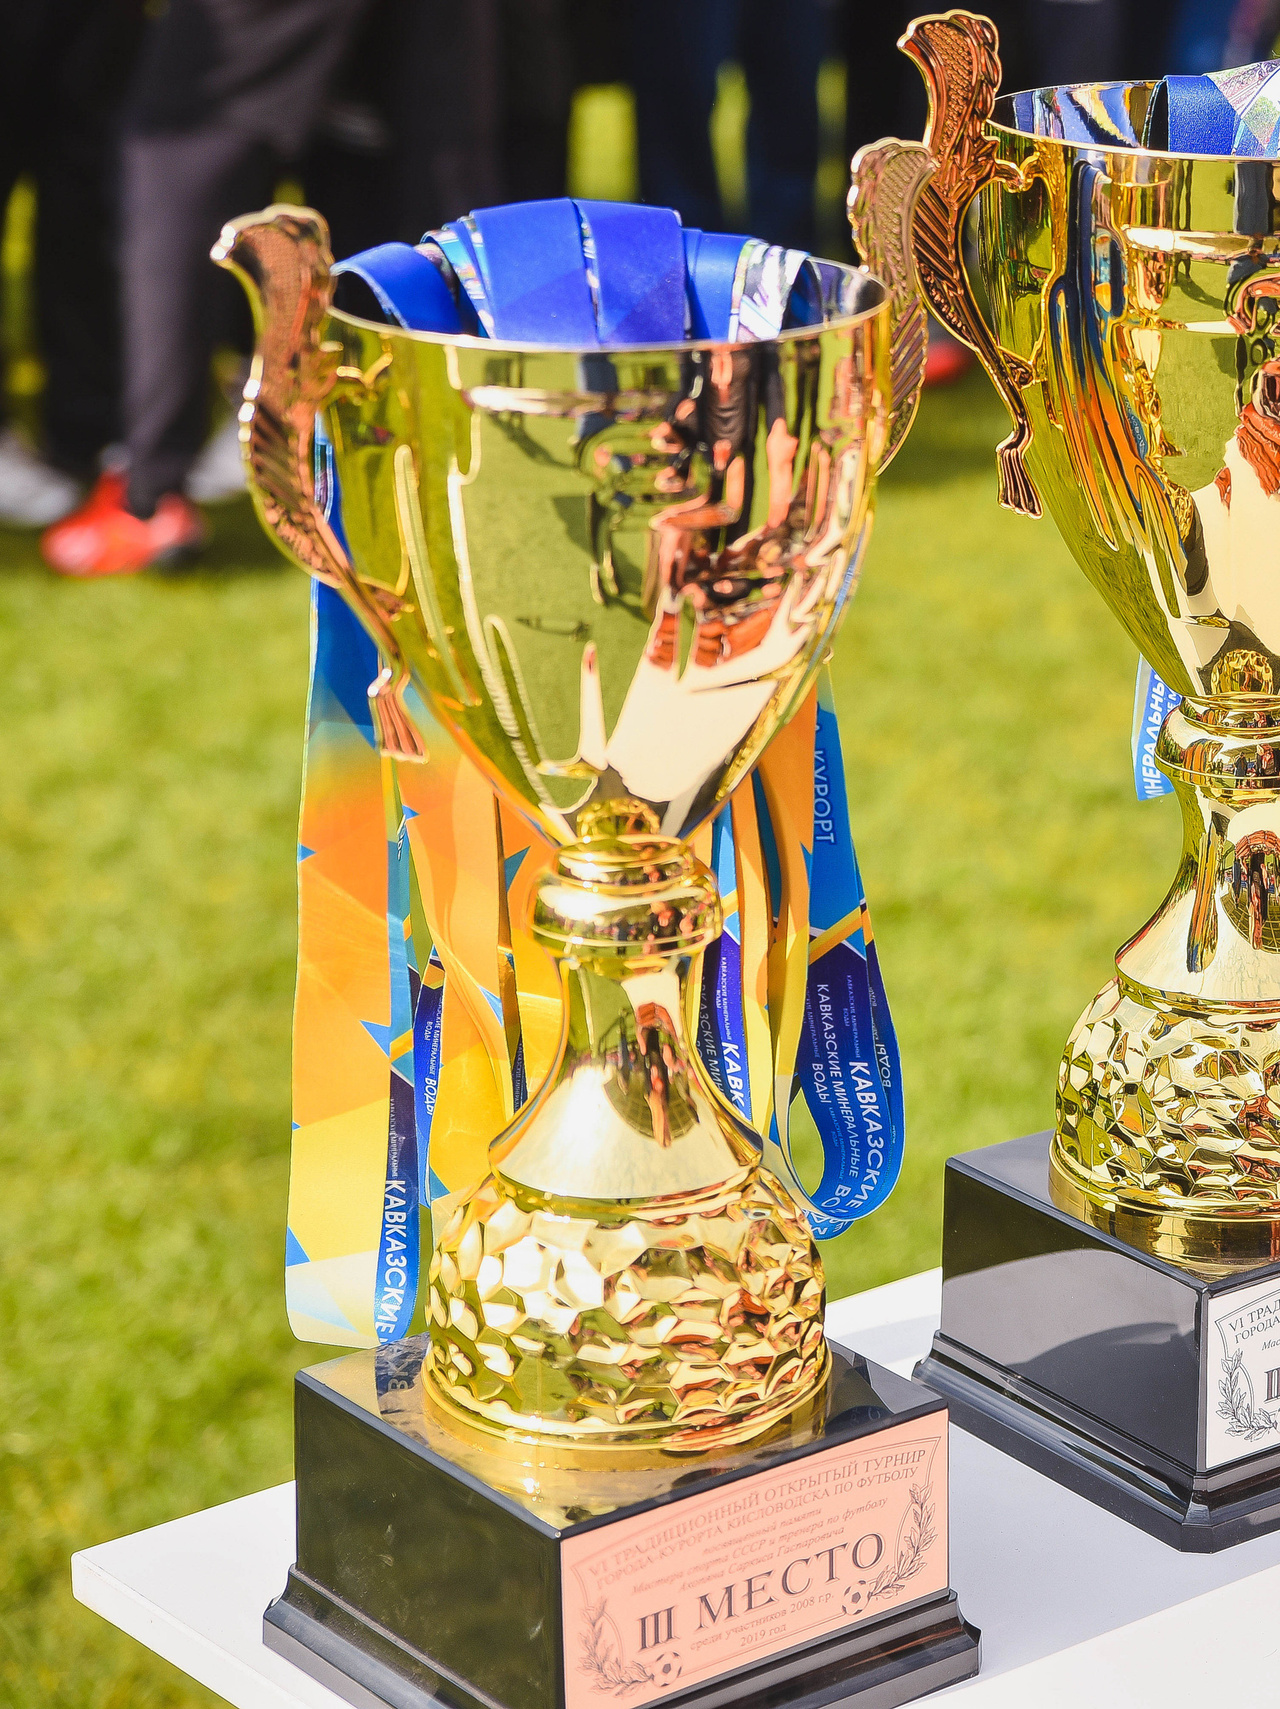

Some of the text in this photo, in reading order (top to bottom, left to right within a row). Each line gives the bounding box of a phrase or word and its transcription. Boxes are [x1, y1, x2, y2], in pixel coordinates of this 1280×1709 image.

[812, 1063, 832, 1104] ВОДЫ
[817, 984, 861, 1179] КАВКАЗСКИЕ МИНЕРАЛЬНЫЕ
[876, 1043, 892, 1088] ВОДЫ
[425, 1078, 437, 1116] ВОДЫ
[849, 1061, 884, 1209] КАВКАЗСКИЕ
[375, 1180, 407, 1334] КАВКАЗСКИЕ
[1228, 1317, 1244, 1332] VI
[613, 1490, 760, 1565] ТРАДИЦИОННЫЙ
[764, 1460, 858, 1502] ОТКРЫТЫЙ
[862, 1450, 926, 1476] ТУРНИР
[727, 1488, 830, 1531] КИСЛОВОДСКА
[834, 1482, 853, 1496] ПО
[857, 1467, 918, 1488] ФУТБОЛУ
[780, 1509, 822, 1529] памяти
[732, 1539, 767, 1559] СССР
[826, 1515, 840, 1524] по
[842, 1498, 888, 1522] футболу
[776, 1526, 845, 1558] Гаспаровича
[637, 1532, 885, 1651] III МЕСТО
[690, 1632, 723, 1651] среди
[725, 1607, 788, 1641] участников
[790, 1596, 815, 1613] 2008
[740, 1622, 787, 1647] 2019 год
